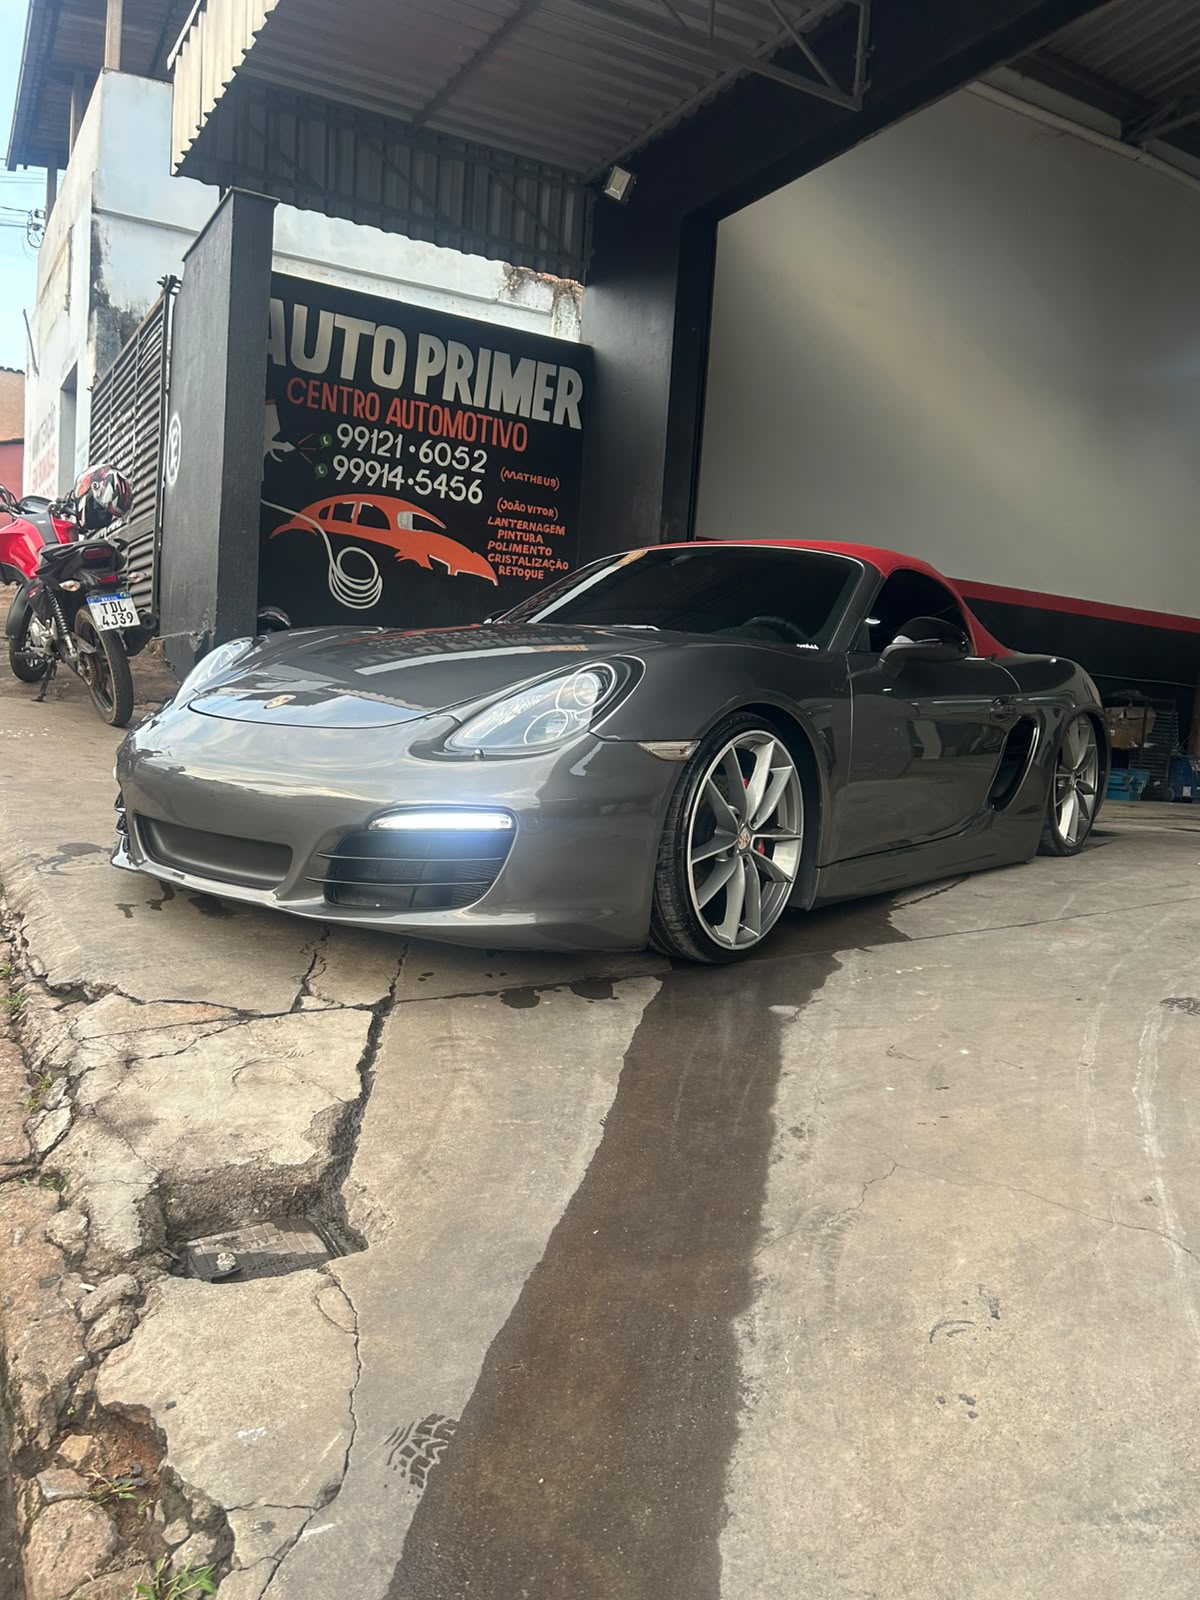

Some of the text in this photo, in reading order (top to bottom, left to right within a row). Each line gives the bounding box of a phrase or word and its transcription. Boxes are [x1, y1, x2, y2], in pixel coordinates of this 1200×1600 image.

[414, 333, 583, 430] PRIMER
[287, 377, 528, 452] CENTRO AUTOMOTIVO
[500, 466, 560, 491] (MATHEUS)
[497, 497, 559, 521] (JOÃO VITOR)
[487, 516, 566, 536] LANTERNAGEM
[497, 529, 543, 544] PINTURA
[487, 540, 553, 557] POLIMENTO
[487, 553, 569, 571] CRISTALIZAÇÃO
[498, 565, 544, 581] RETOQUE
[100, 600, 127, 615] TDL
[102, 611, 134, 627] 4J39
